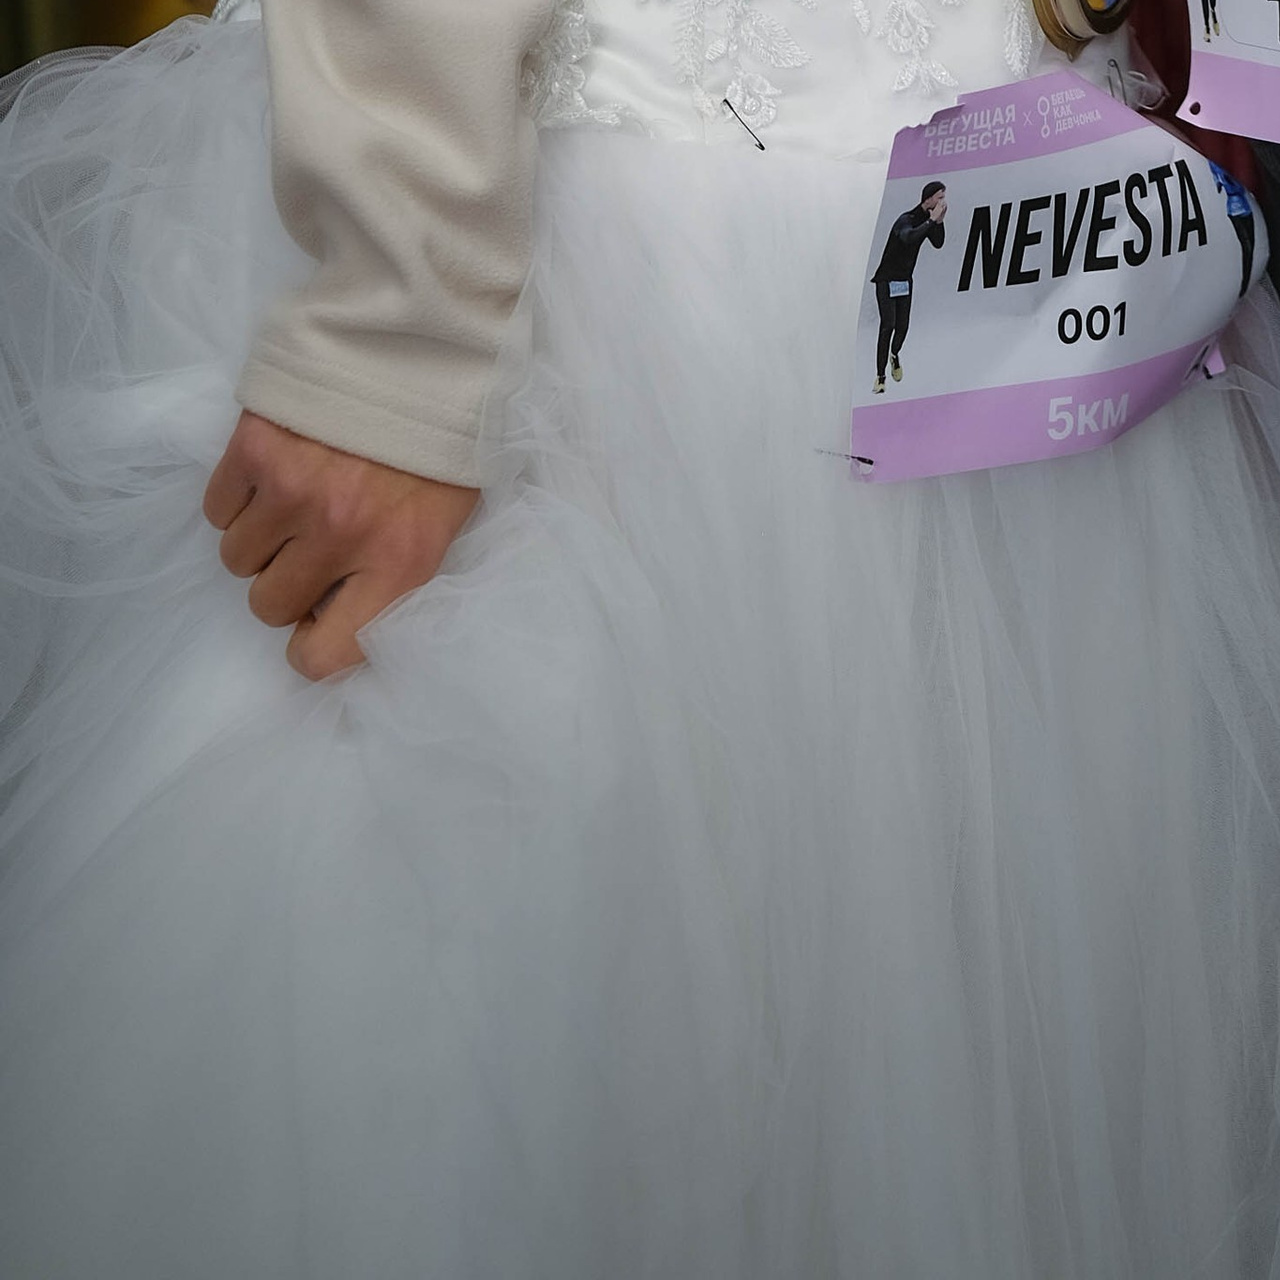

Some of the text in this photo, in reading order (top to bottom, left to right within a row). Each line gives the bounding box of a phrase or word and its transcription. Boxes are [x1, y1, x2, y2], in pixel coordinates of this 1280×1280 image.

[1053, 103, 1073, 120] КАК
[1055, 109, 1102, 135] ДЕВЧОНКА
[927, 127, 1016, 157] НЕВЕСТА
[957, 159, 1208, 292] NEVESTA
[1057, 301, 1127, 345] 001
